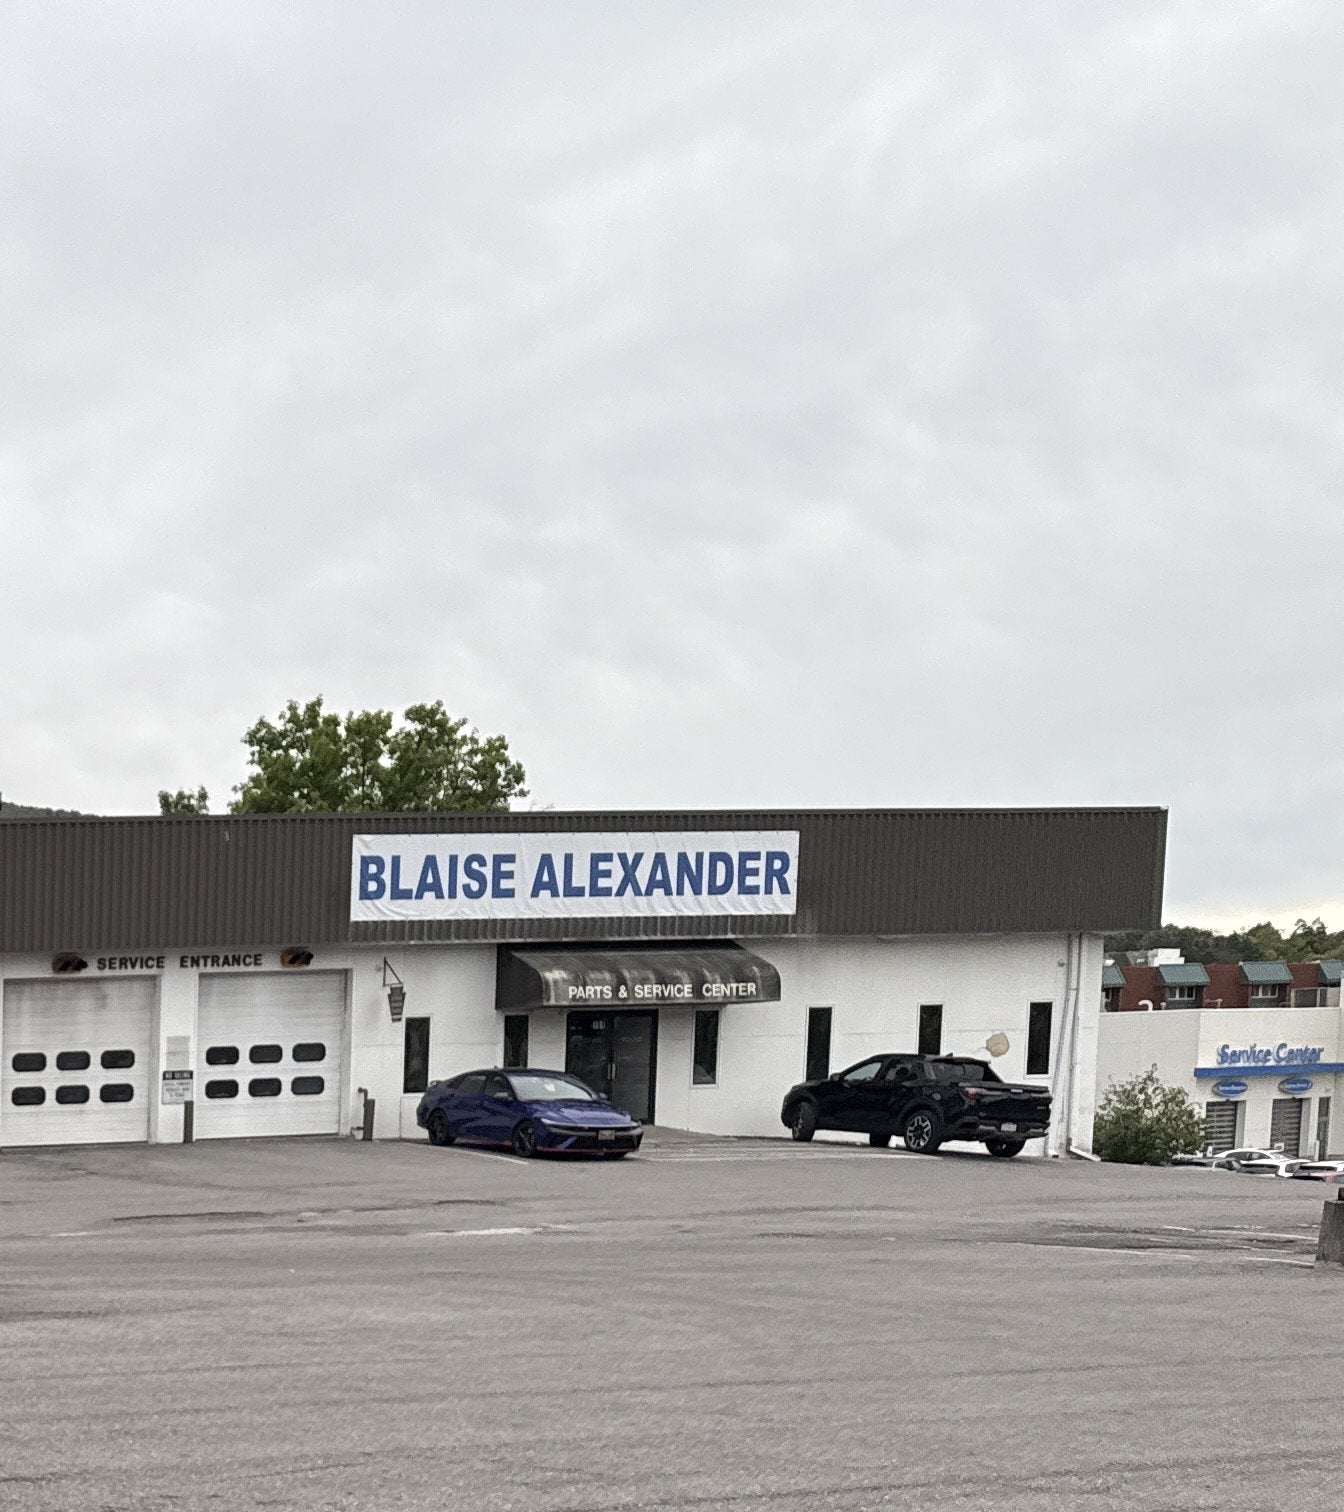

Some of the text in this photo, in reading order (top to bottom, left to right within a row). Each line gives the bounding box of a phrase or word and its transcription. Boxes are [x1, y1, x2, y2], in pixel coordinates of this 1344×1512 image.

[358, 850, 792, 902] BLAISE ALEXANDER
[97, 953, 263, 970] SERVICE ENTRANCE
[568, 982, 757, 1000] PARTS & SERVICE CENTER
[1217, 1042, 1325, 1065] Service Center
